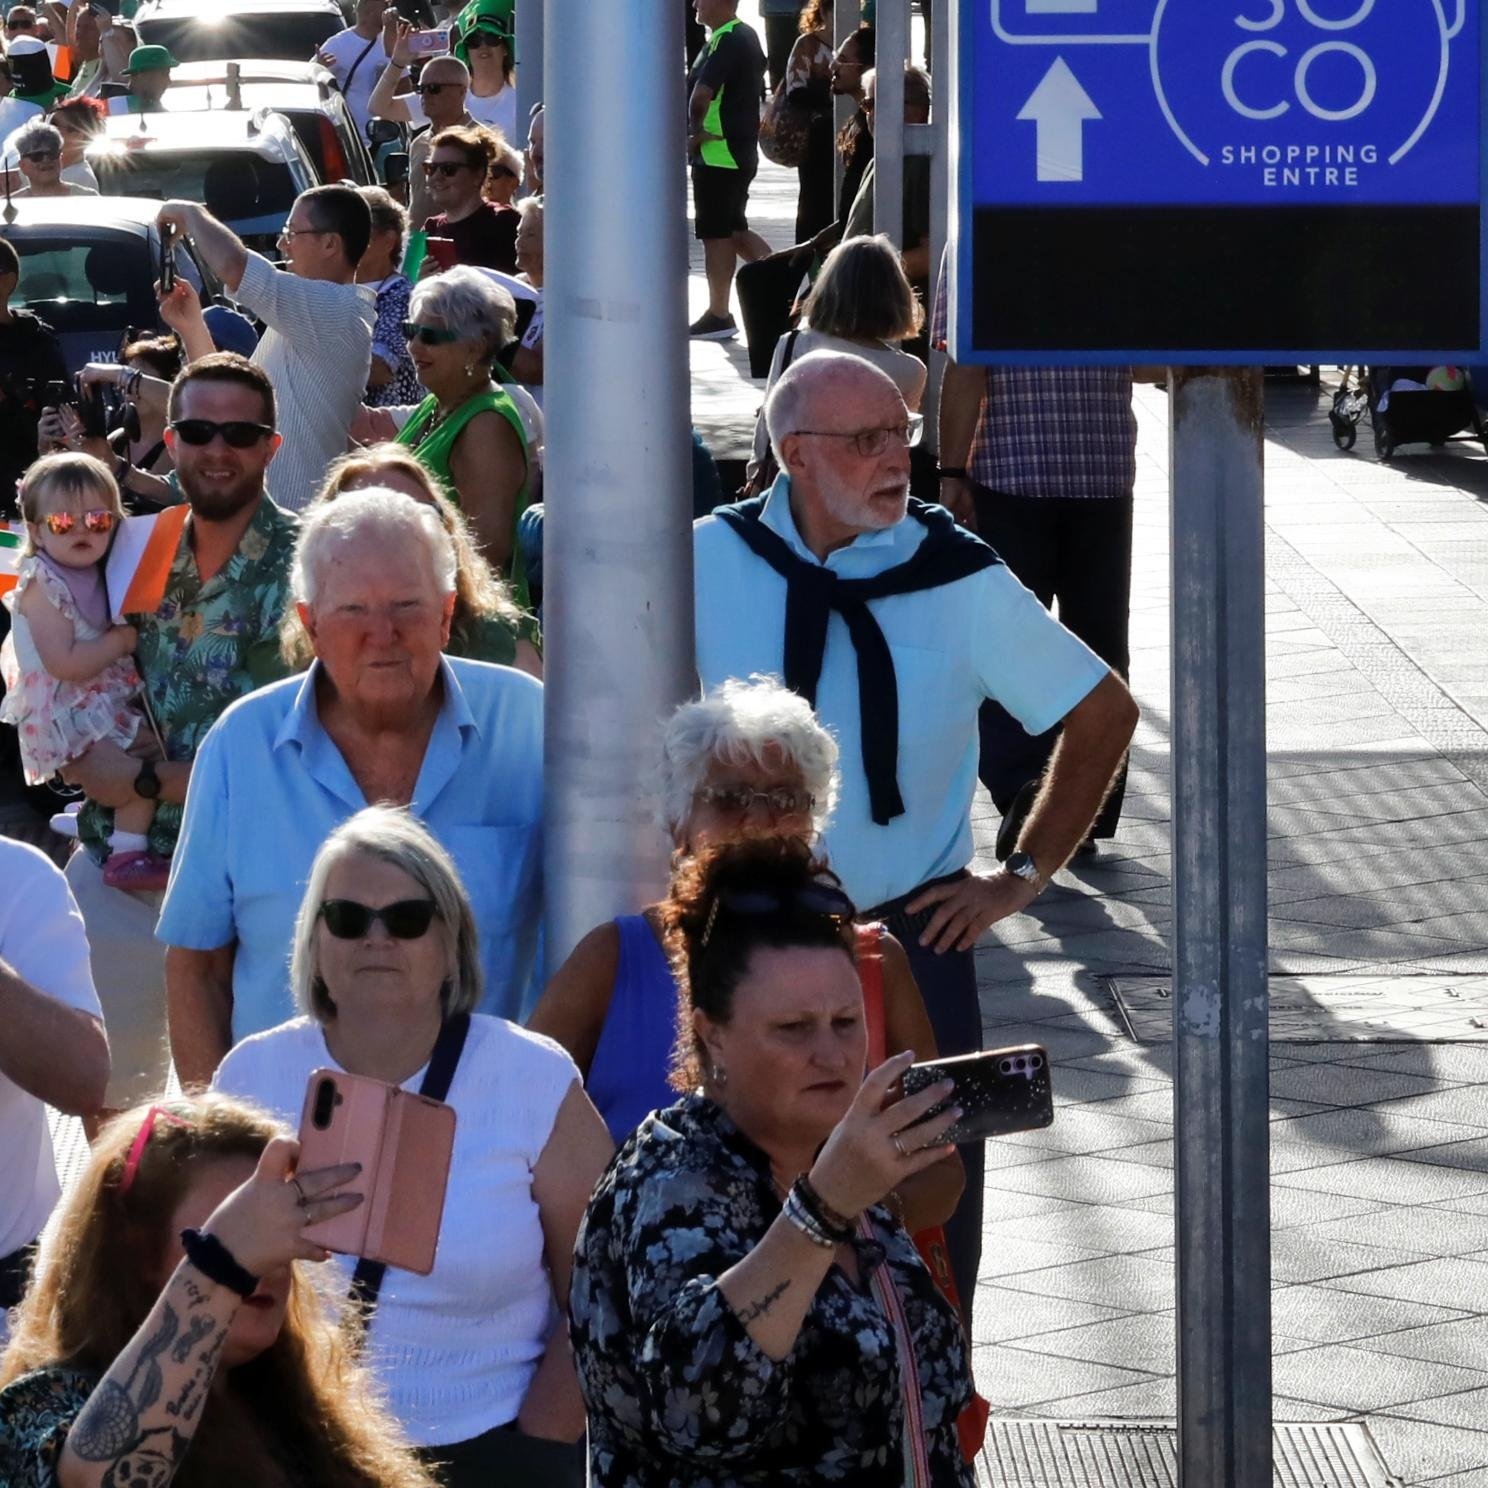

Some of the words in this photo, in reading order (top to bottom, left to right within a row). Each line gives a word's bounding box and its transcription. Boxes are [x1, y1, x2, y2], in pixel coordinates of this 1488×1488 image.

[1221, 40, 1376, 120] CO
[1222, 145, 1378, 164] SHOPPING
[1263, 168, 1359, 186] ENTRE
